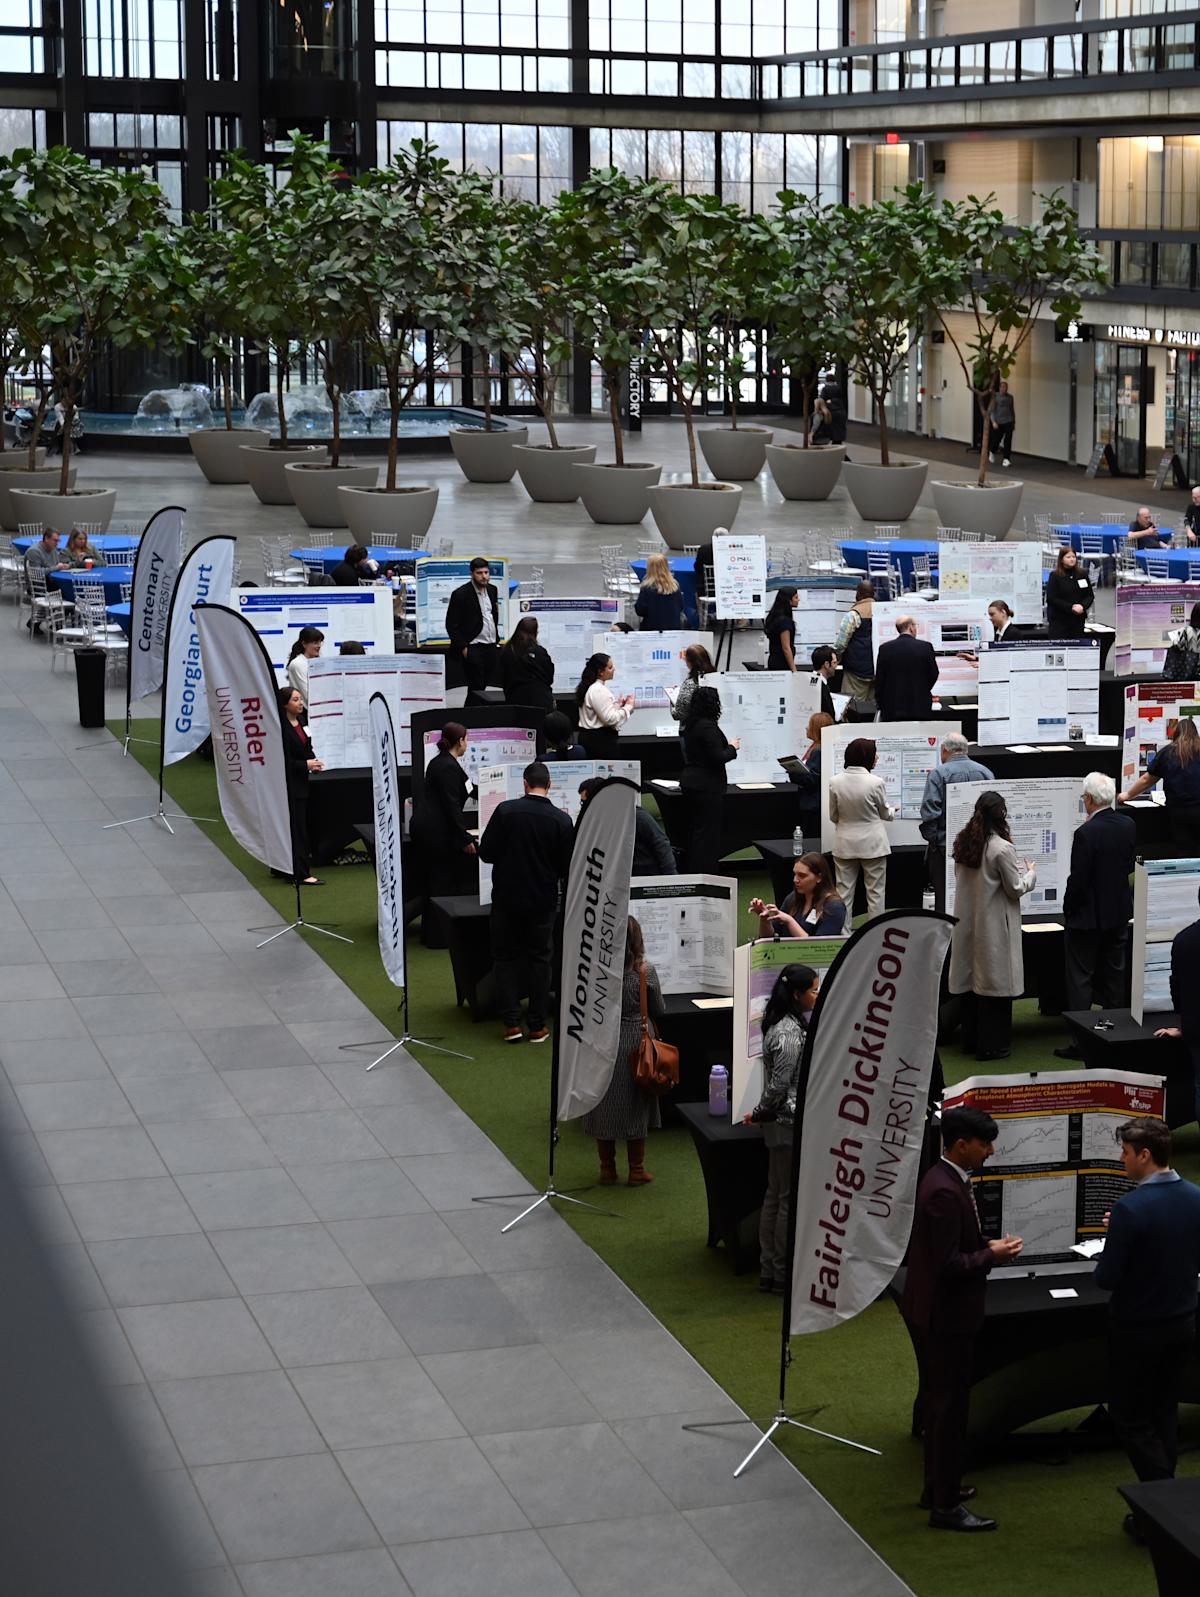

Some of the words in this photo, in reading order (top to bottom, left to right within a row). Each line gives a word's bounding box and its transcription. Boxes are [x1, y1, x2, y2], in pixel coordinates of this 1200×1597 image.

[138, 551, 164, 652] Centenary
[155, 572, 173, 648] UNIVERSITY
[176, 633, 202, 733] Georgian
[240, 697, 266, 766] Rider
[215, 686, 244, 785] UNIVERSITY
[377, 798, 391, 907] UNIVERSITY
[381, 730, 391, 802] Saint
[387, 812, 400, 950] Elizabeth
[567, 846, 605, 1044] Monmouth
[592, 892, 617, 1025] UNIVERSITY
[810, 1137, 865, 1309] Fairleigh
[838, 927, 910, 1126] Dickinson
[867, 1057, 921, 1219] UNIVERSITY
[990, 1087, 1009, 1096] Speed
[1006, 1091, 1042, 1100] Atmospheric
[1043, 1088, 1091, 1096] Characterization
